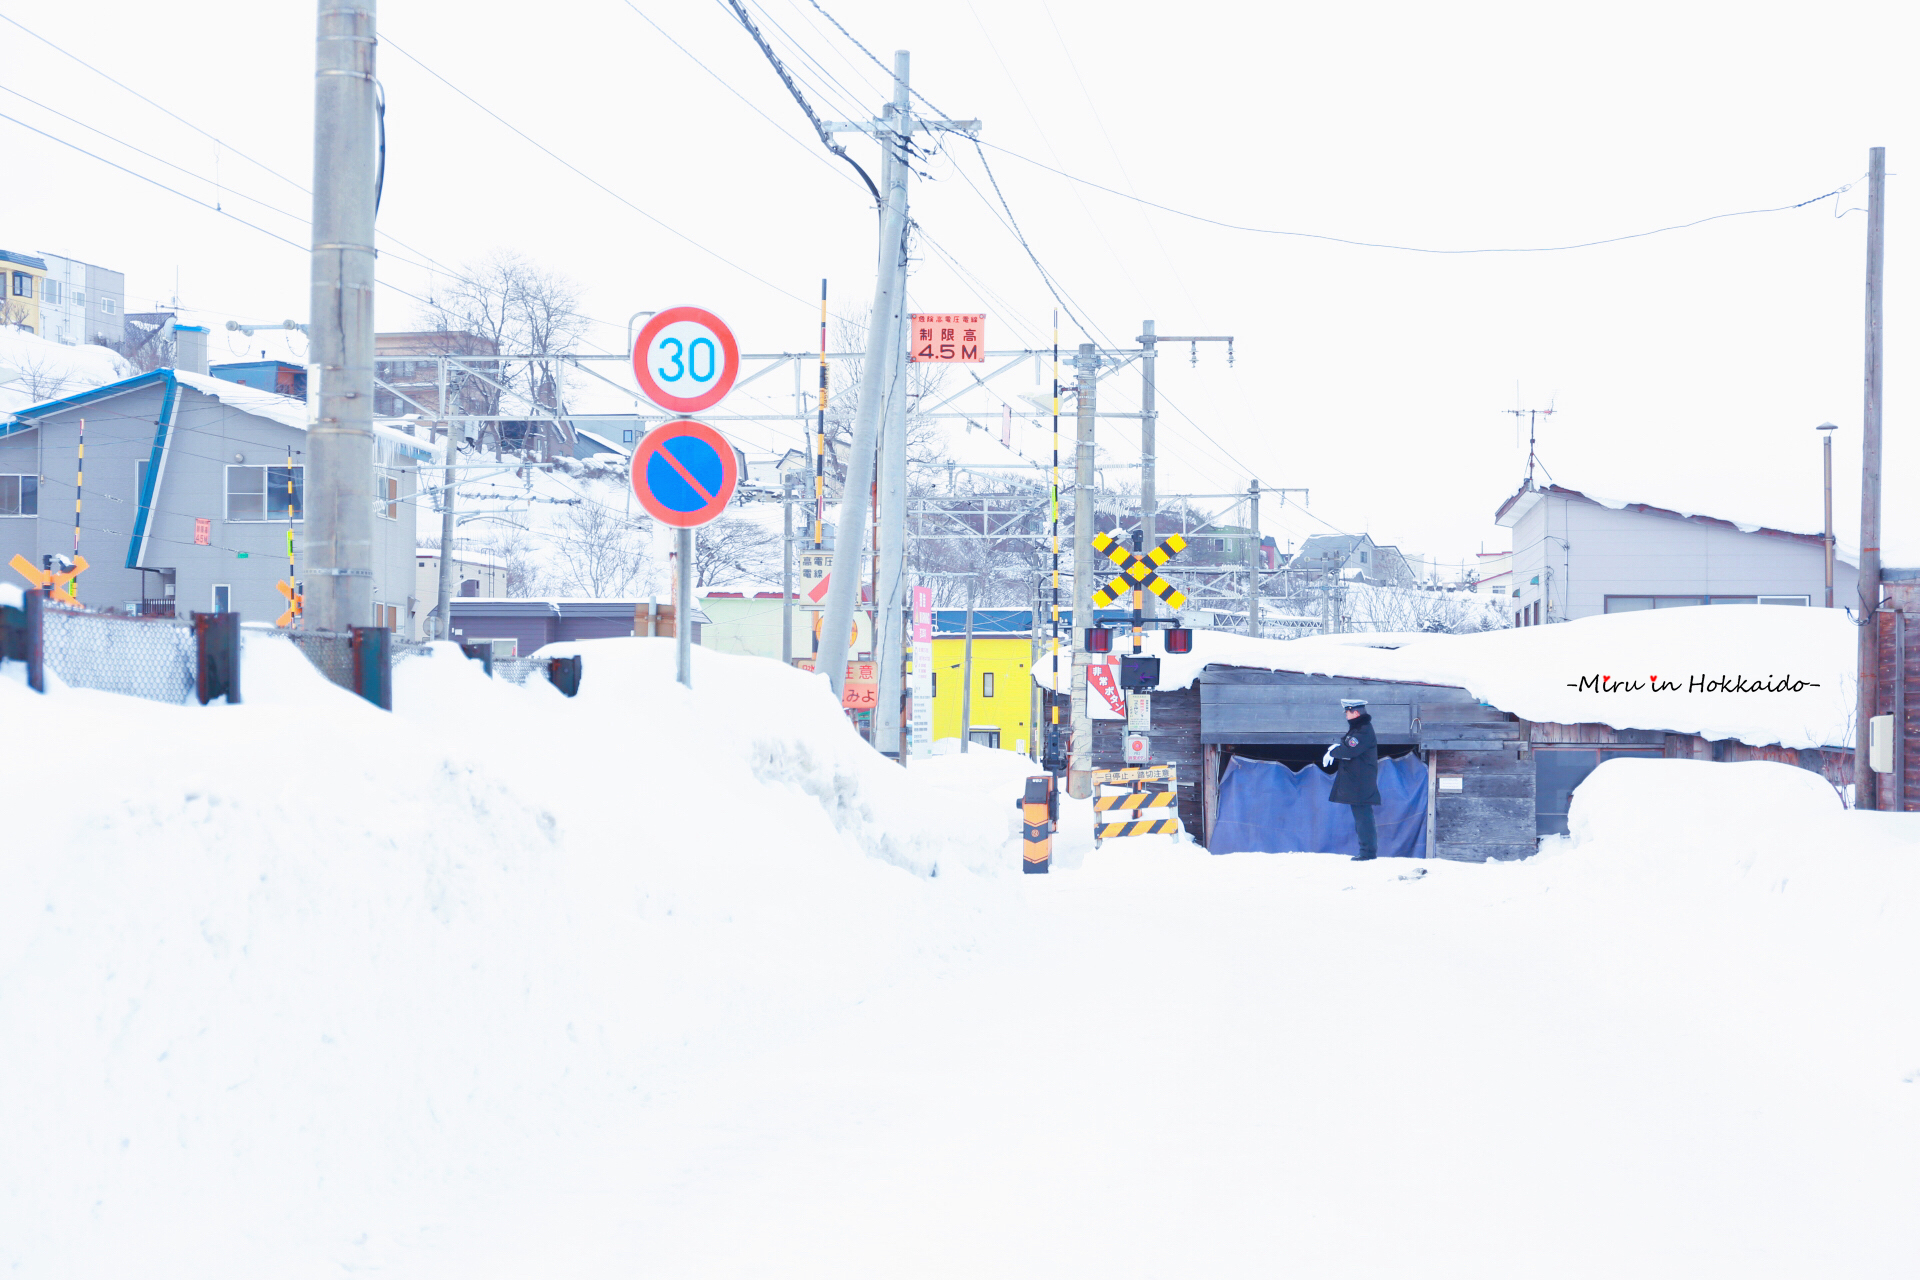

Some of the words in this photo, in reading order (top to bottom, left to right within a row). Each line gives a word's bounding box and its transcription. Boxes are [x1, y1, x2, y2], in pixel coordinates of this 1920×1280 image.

[919, 328, 977, 342] 制限高
[657, 337, 716, 383] 30
[802, 568, 824, 579] 電線
[1092, 666, 1124, 712] 非常ボタン
